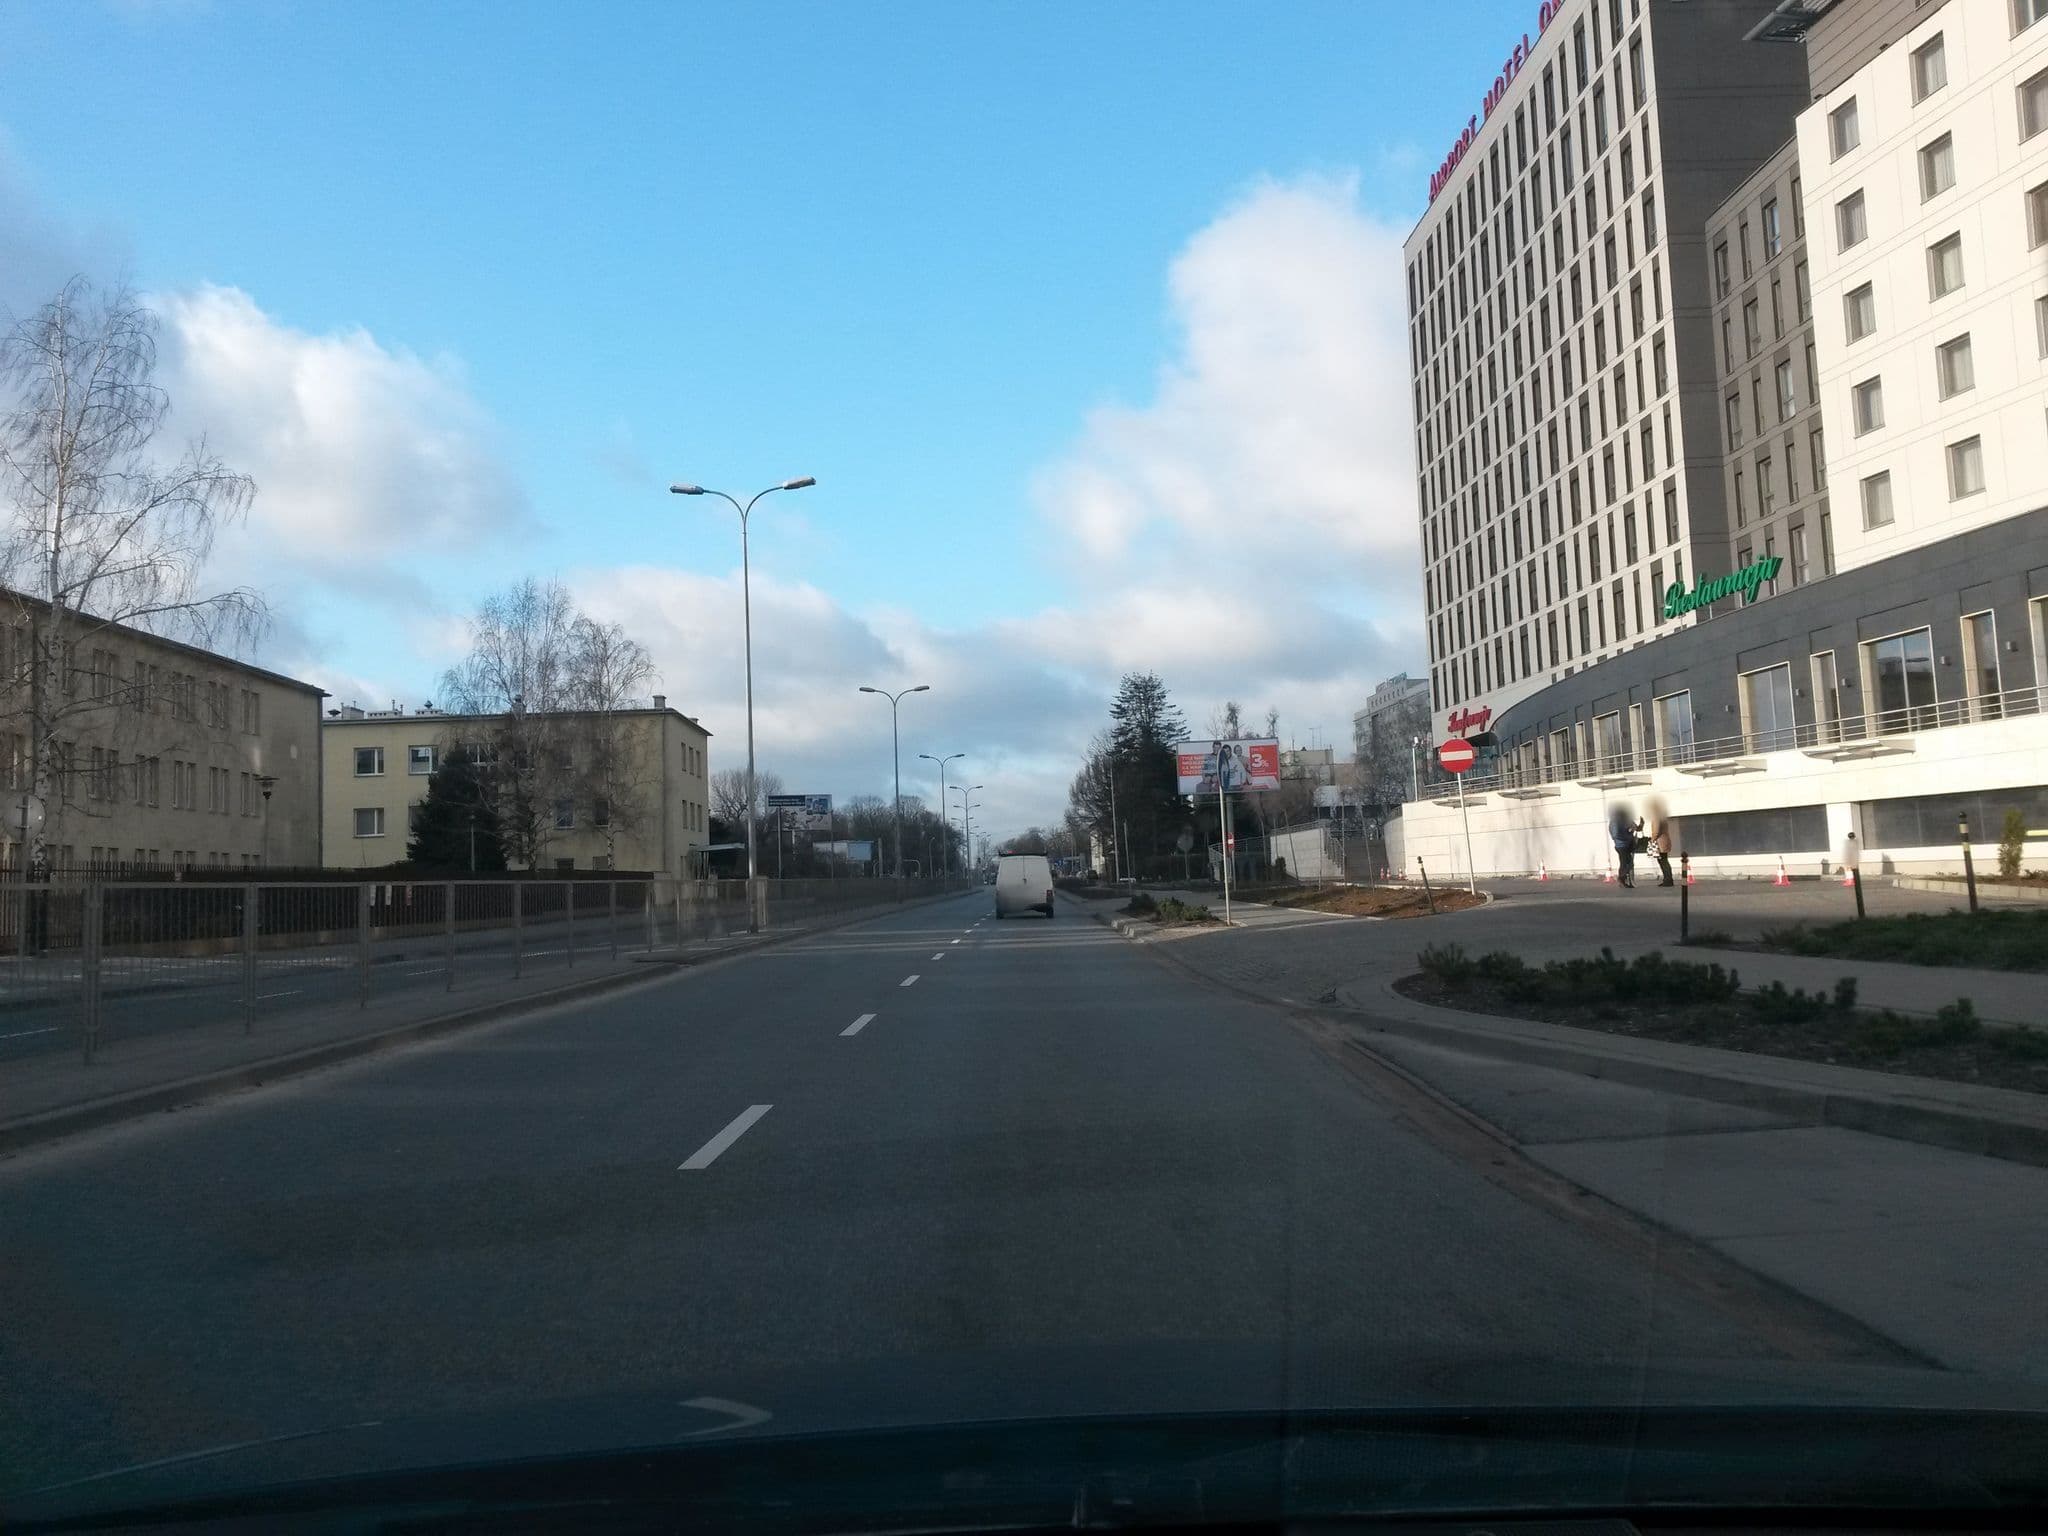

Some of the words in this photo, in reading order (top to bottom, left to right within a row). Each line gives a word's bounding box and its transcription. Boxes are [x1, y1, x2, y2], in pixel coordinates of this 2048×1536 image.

[1429, 114, 1477, 201] AIRPORT
[1483, 33, 1530, 121] HOTEL
[1663, 554, 1784, 619] Restauracja
